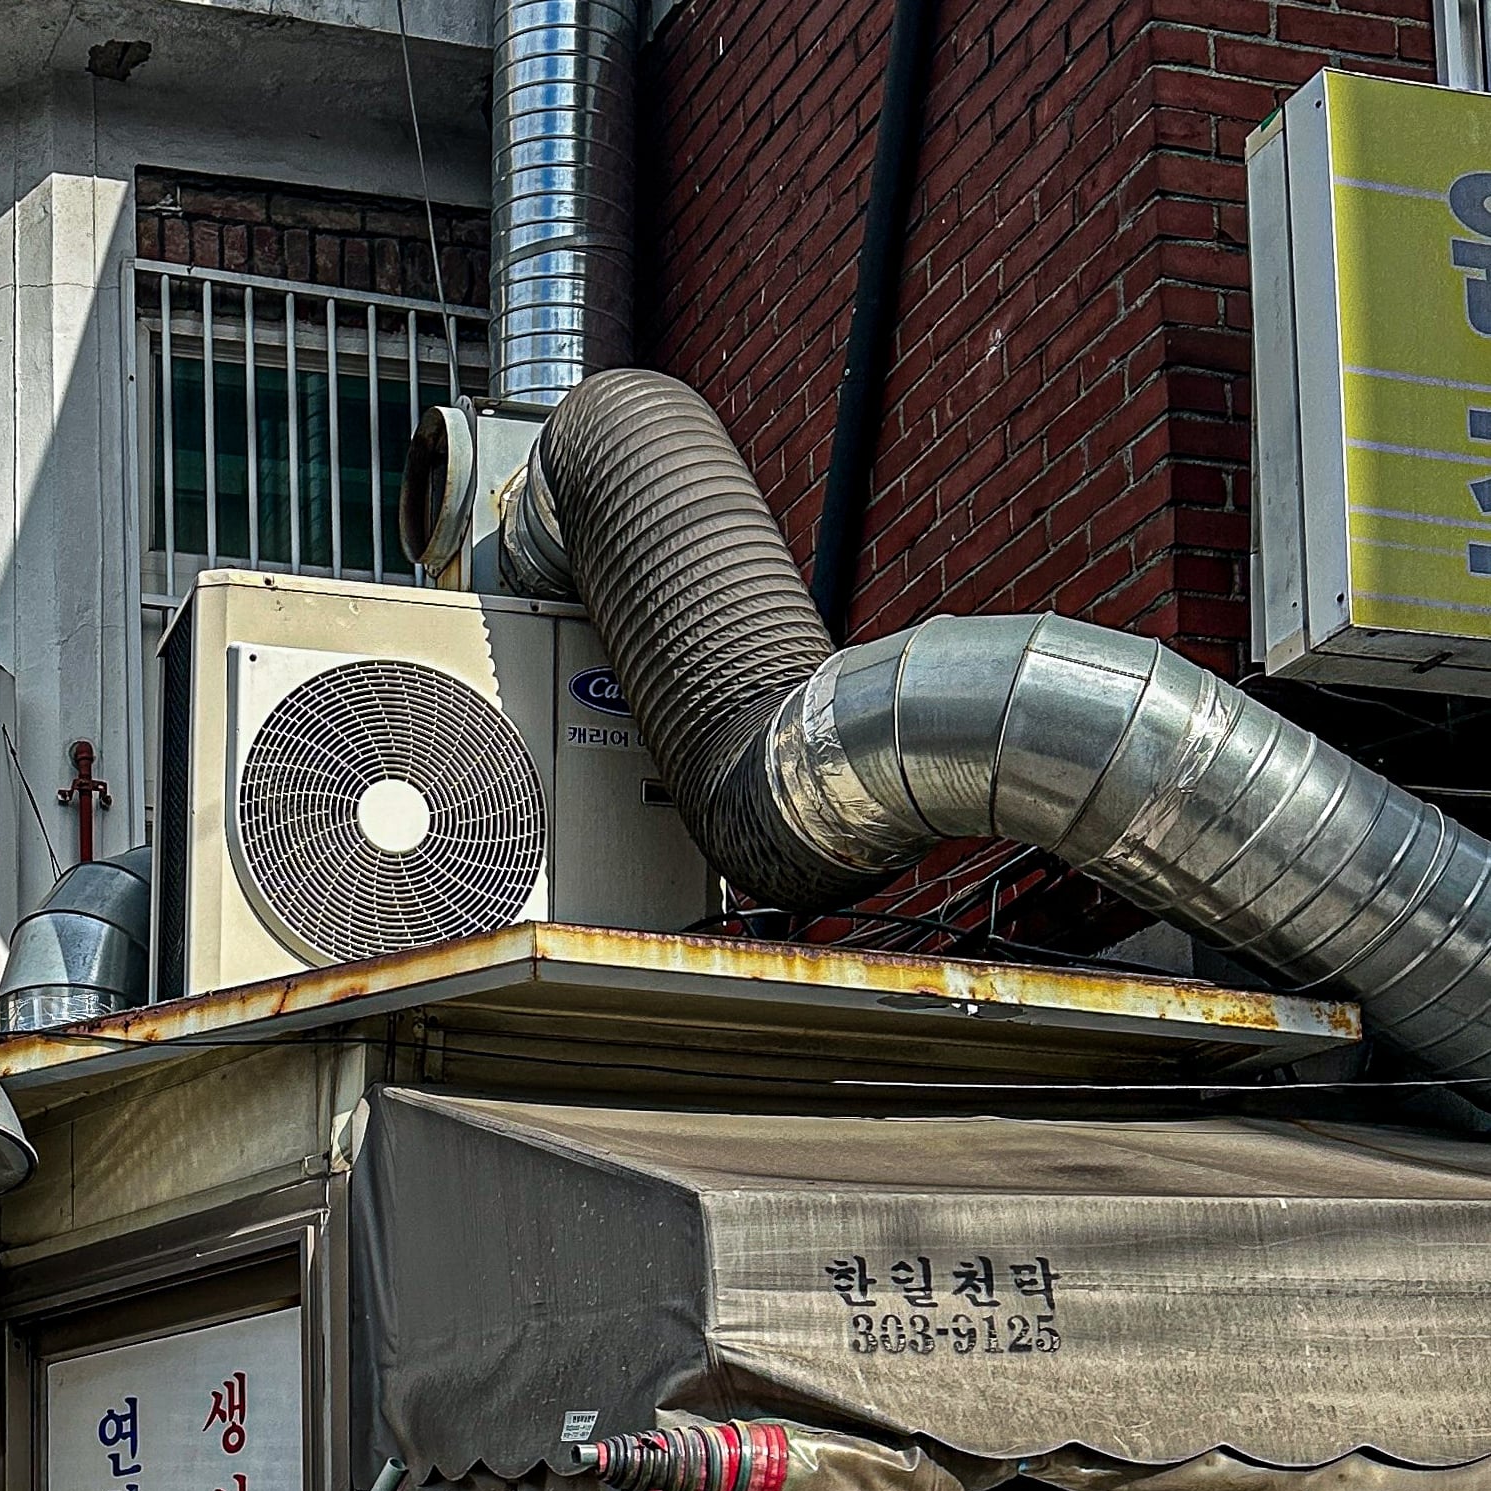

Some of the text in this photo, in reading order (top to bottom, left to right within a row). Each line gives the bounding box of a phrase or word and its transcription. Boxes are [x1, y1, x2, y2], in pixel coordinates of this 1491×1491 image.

[568, 727, 629, 747] 캐리어
[825, 1255, 1061, 1309] 한일천막
[851, 1314, 1062, 1354] 303-9125
